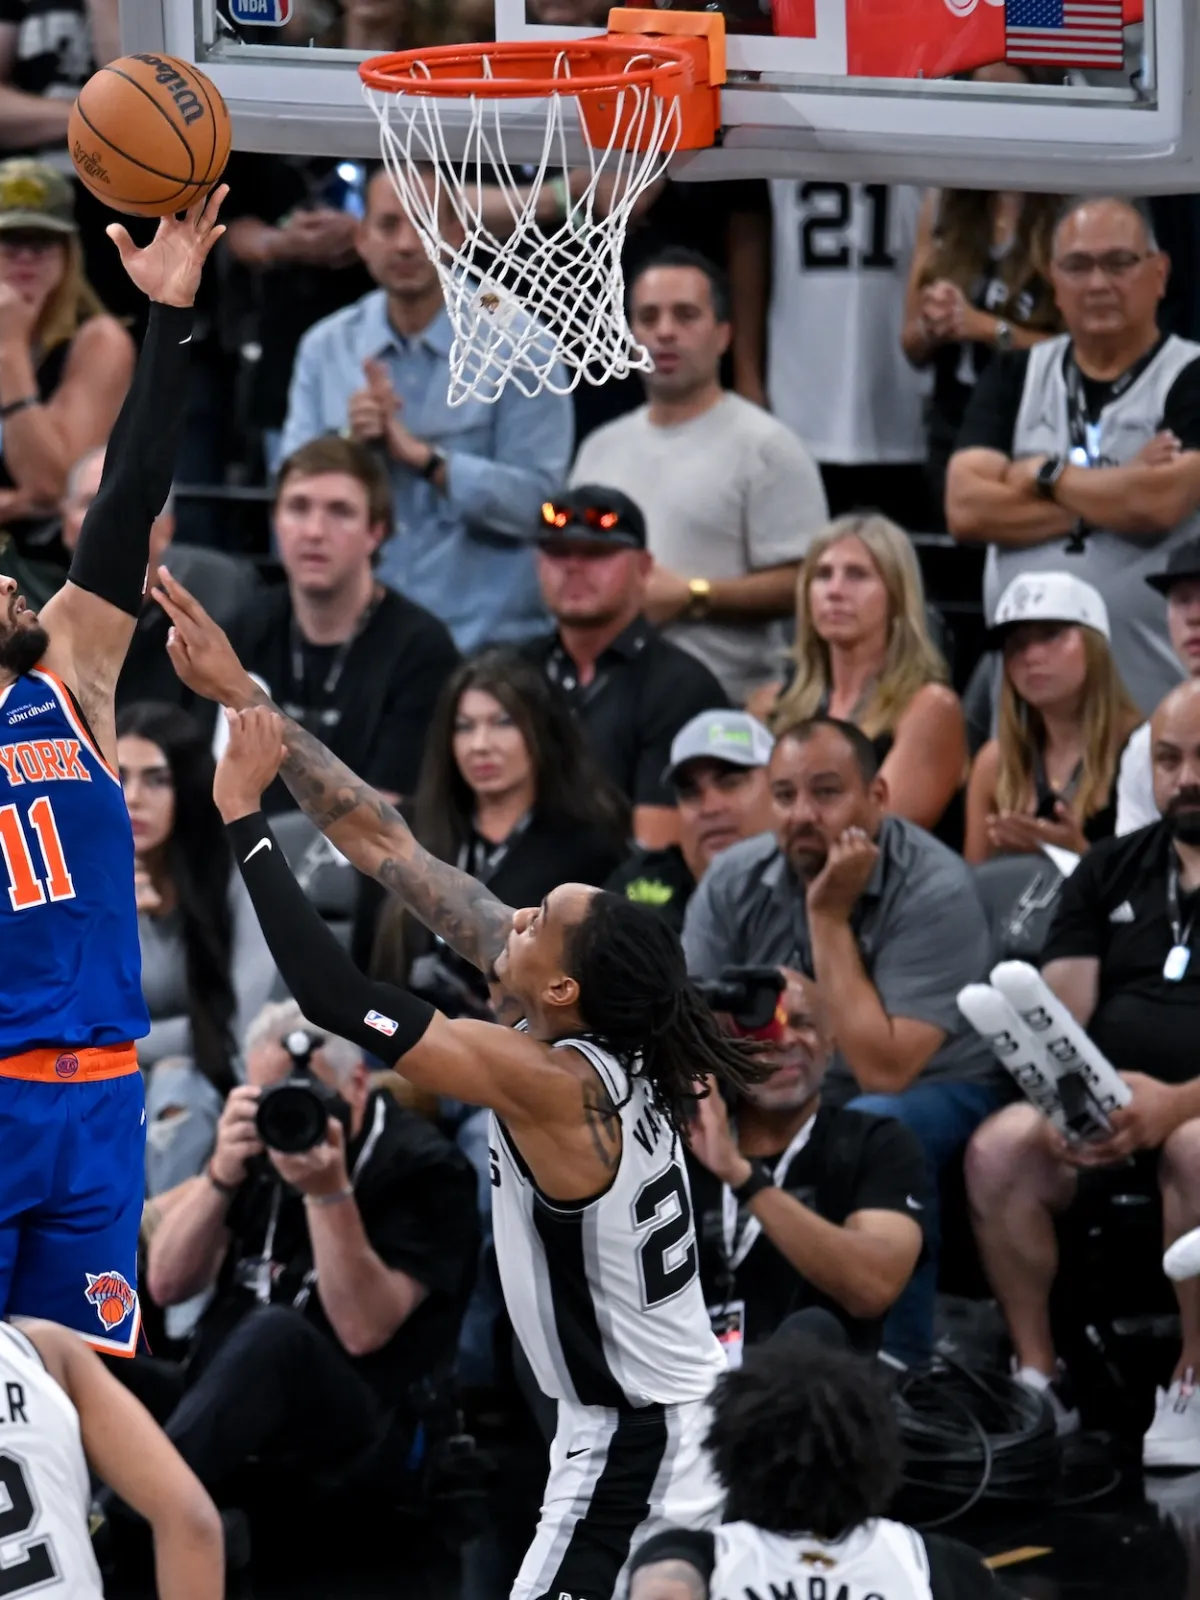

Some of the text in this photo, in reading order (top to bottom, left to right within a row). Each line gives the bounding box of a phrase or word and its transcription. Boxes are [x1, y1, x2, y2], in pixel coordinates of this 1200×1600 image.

[238, 0, 268, 13] NBA
[126, 52, 205, 127] Wilson
[797, 181, 896, 271] 21
[8, 699, 56, 725] abu dhabi
[630, 1160, 700, 1313] 2
